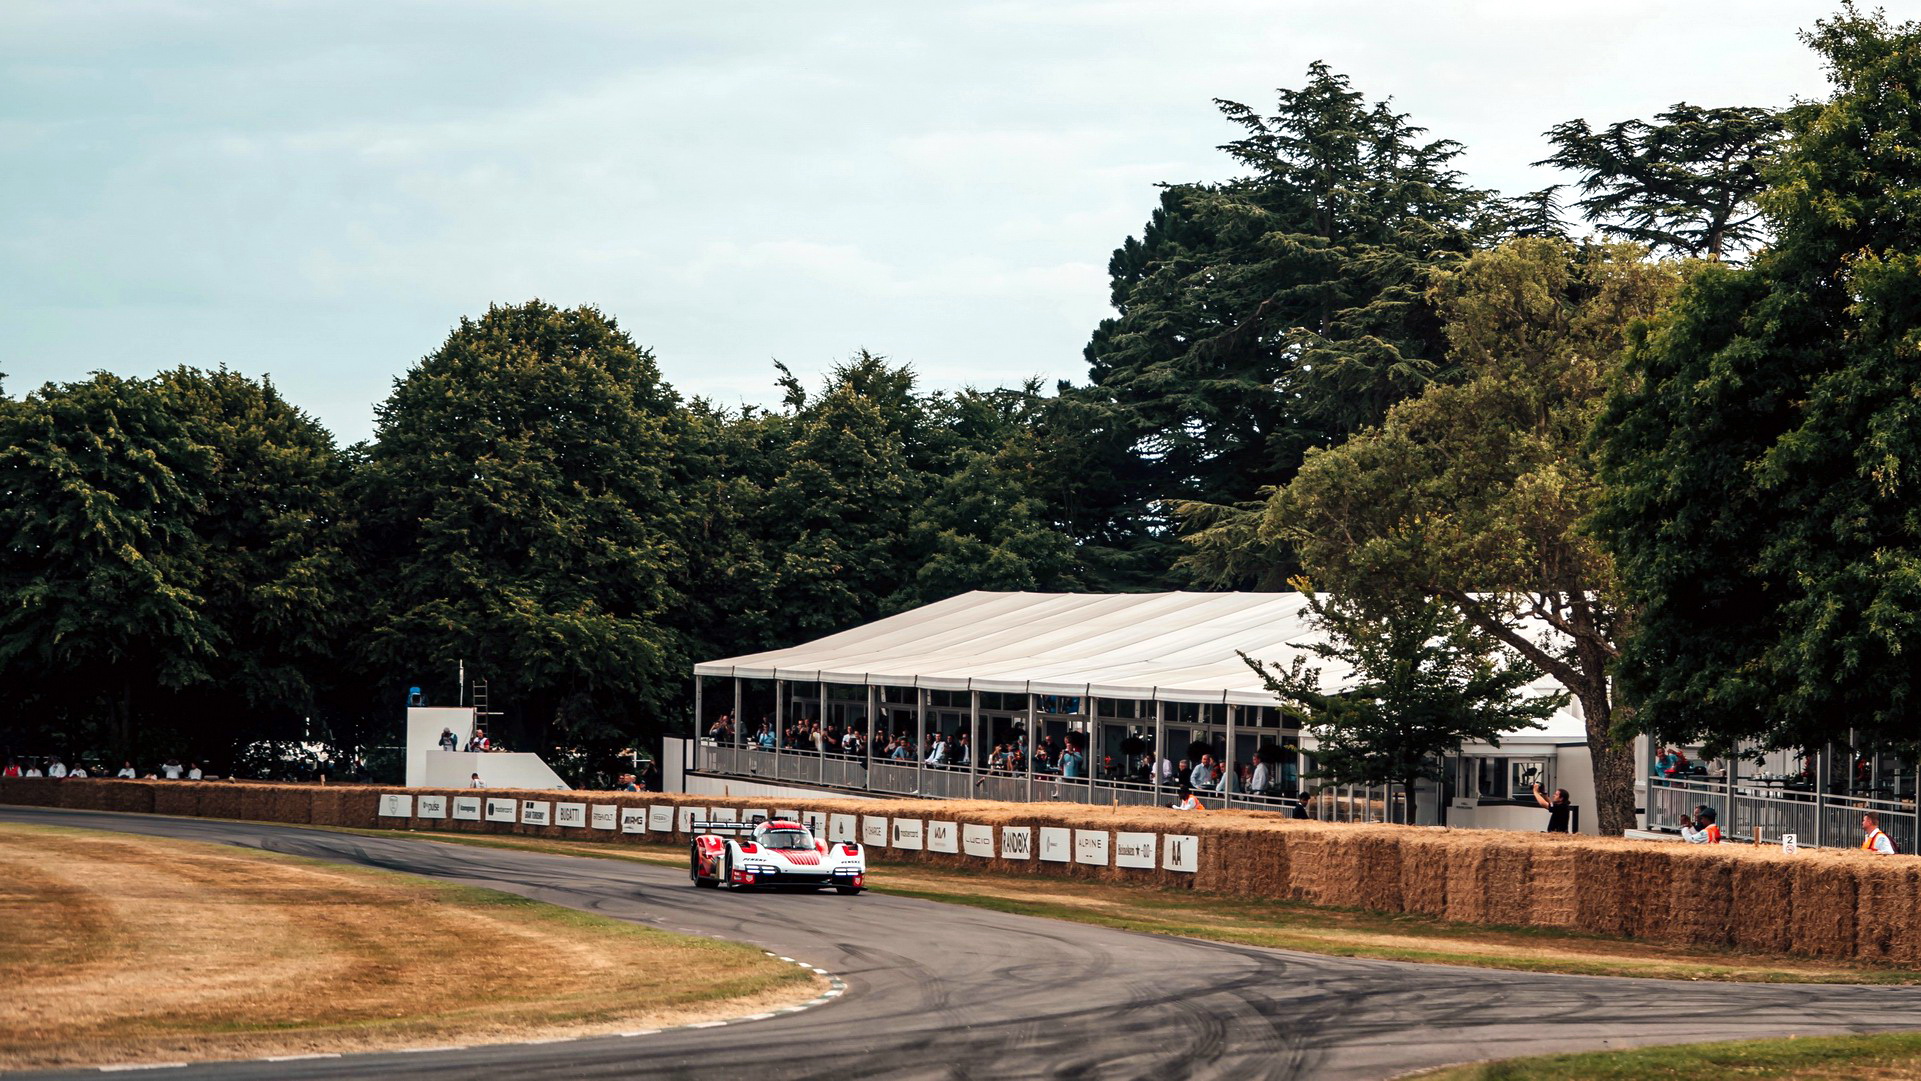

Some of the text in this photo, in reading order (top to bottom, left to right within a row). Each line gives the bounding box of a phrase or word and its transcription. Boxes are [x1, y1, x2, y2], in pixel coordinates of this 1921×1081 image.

[560, 807, 580, 821] BUGATTI
[965, 836, 990, 845] LUCID
[1003, 832, 1029, 854] RANDOX
[1079, 838, 1102, 849] ALPINE
[1787, 835, 1793, 844] 2
[1172, 840, 1182, 866] AA
